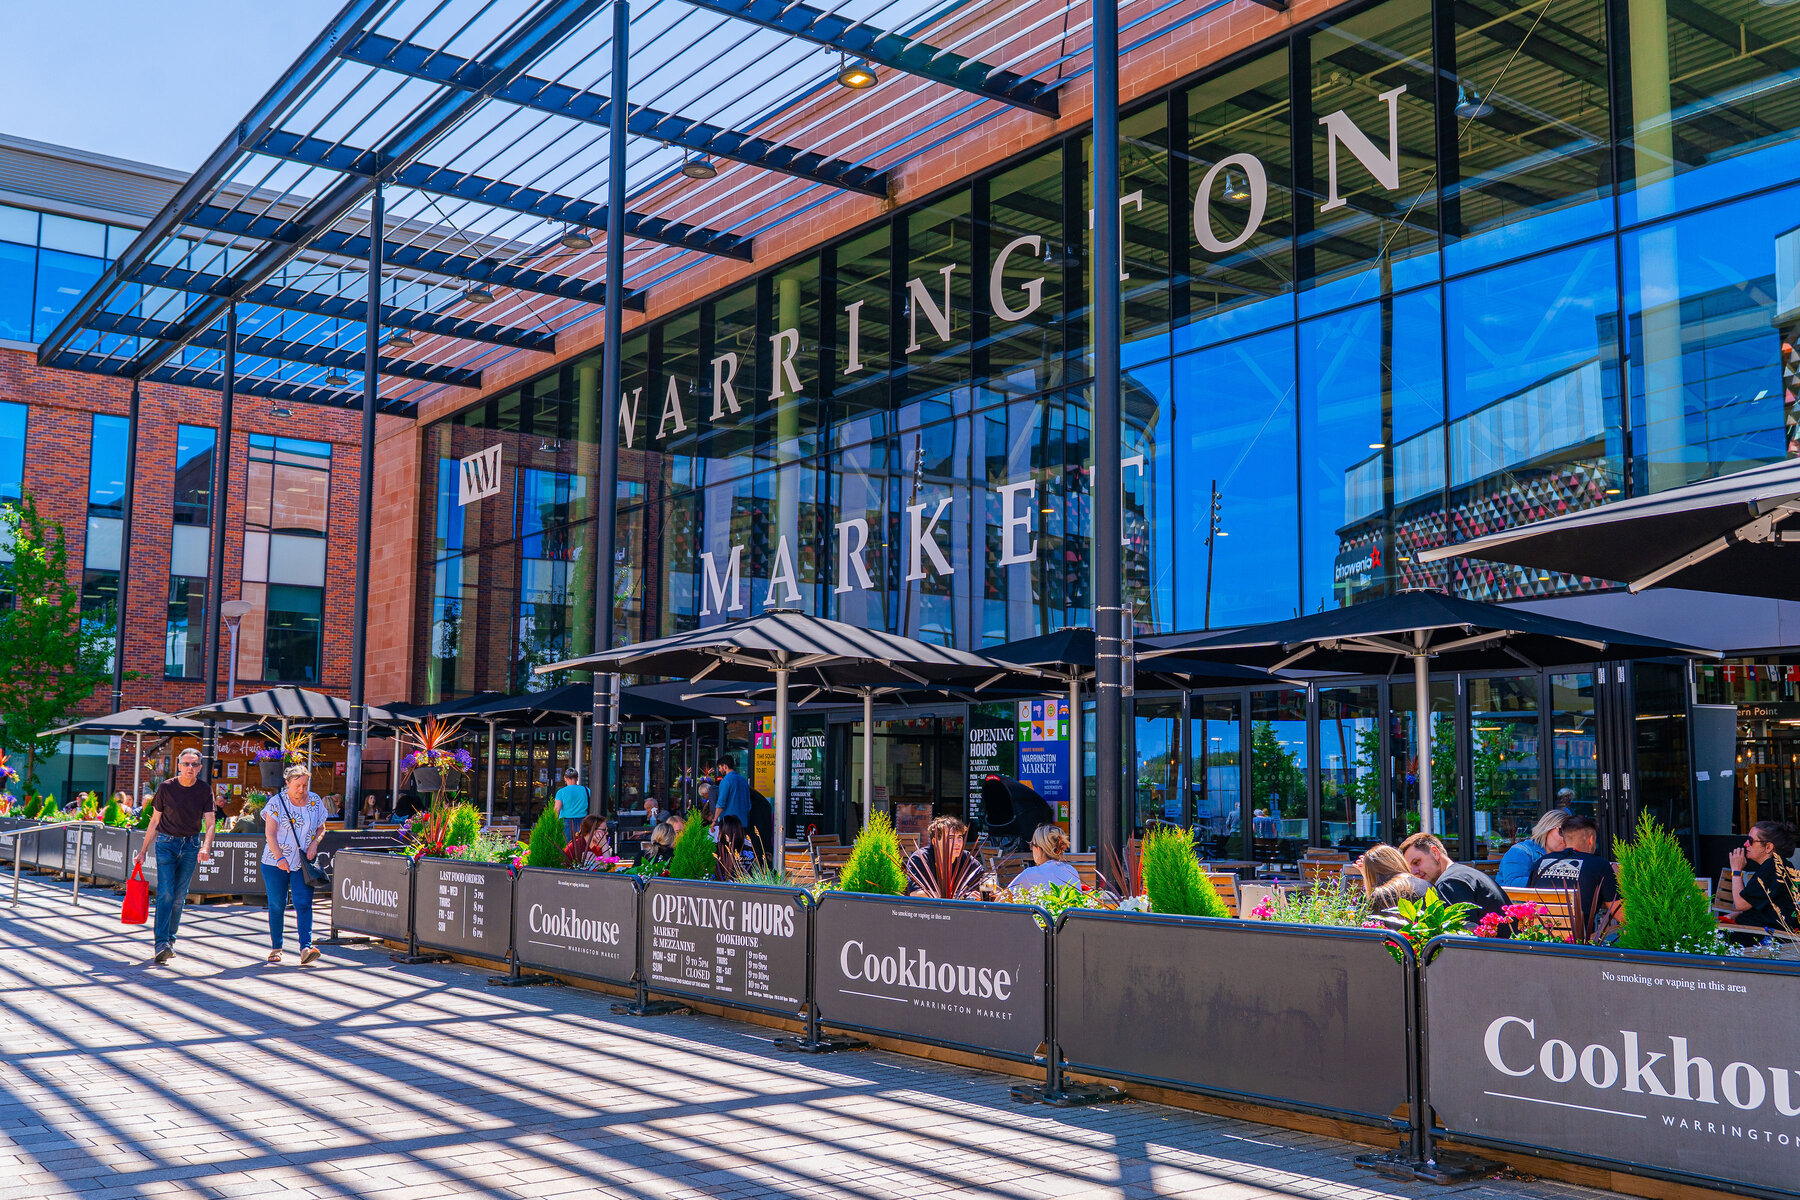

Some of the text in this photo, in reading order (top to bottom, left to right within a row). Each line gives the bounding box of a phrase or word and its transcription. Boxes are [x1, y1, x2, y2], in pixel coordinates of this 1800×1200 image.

[1754, 708, 1778, 716] Point
[970, 728, 1014, 742] OPENING
[792, 736, 825, 747] OPENING
[792, 748, 812, 760] HOURS
[970, 743, 997, 756] HOURS
[1022, 754, 1056, 762] WARRINGTON
[1022, 763, 1056, 774] MARKET
[233, 841, 258, 849] ORDERS
[440, 870, 485, 885] LAST FOOD ORDERS
[342, 878, 398, 908] Cookhouse
[474, 888, 484, 900] 5 PM
[474, 901, 477, 912] 8
[473, 914, 483, 925] 9 PM
[652, 894, 794, 938] OPENING HOURS
[898, 911, 913, 919] smoking
[529, 904, 620, 945] Cookhouse
[473, 927, 483, 938] 6 PM
[654, 926, 679, 938] MARKET
[653, 938, 695, 952] & MEZZANINE
[716, 933, 758, 948] COOKHOUSE
[568, 946, 598, 956] WARRINGTON
[652, 951, 663, 961] MON
[667, 953, 677, 963] SAT
[749, 951, 752, 959] 9
[652, 962, 662, 972] SUN
[686, 956, 690, 965] 9
[698, 957, 708, 968] 5PM
[686, 967, 710, 980] CLOSED
[748, 970, 752, 978] 9
[840, 940, 1011, 1000] Cookhouse
[1602, 972, 1614, 981] No
[1617, 974, 1652, 986] smoking
[1666, 978, 1695, 990] vaping
[1698, 980, 1706, 989] in
[1708, 981, 1725, 991] this
[1727, 984, 1747, 992] area
[914, 999, 1012, 1021] WARRINGTON MARKET
[1483, 1016, 1800, 1116] Cookhou
